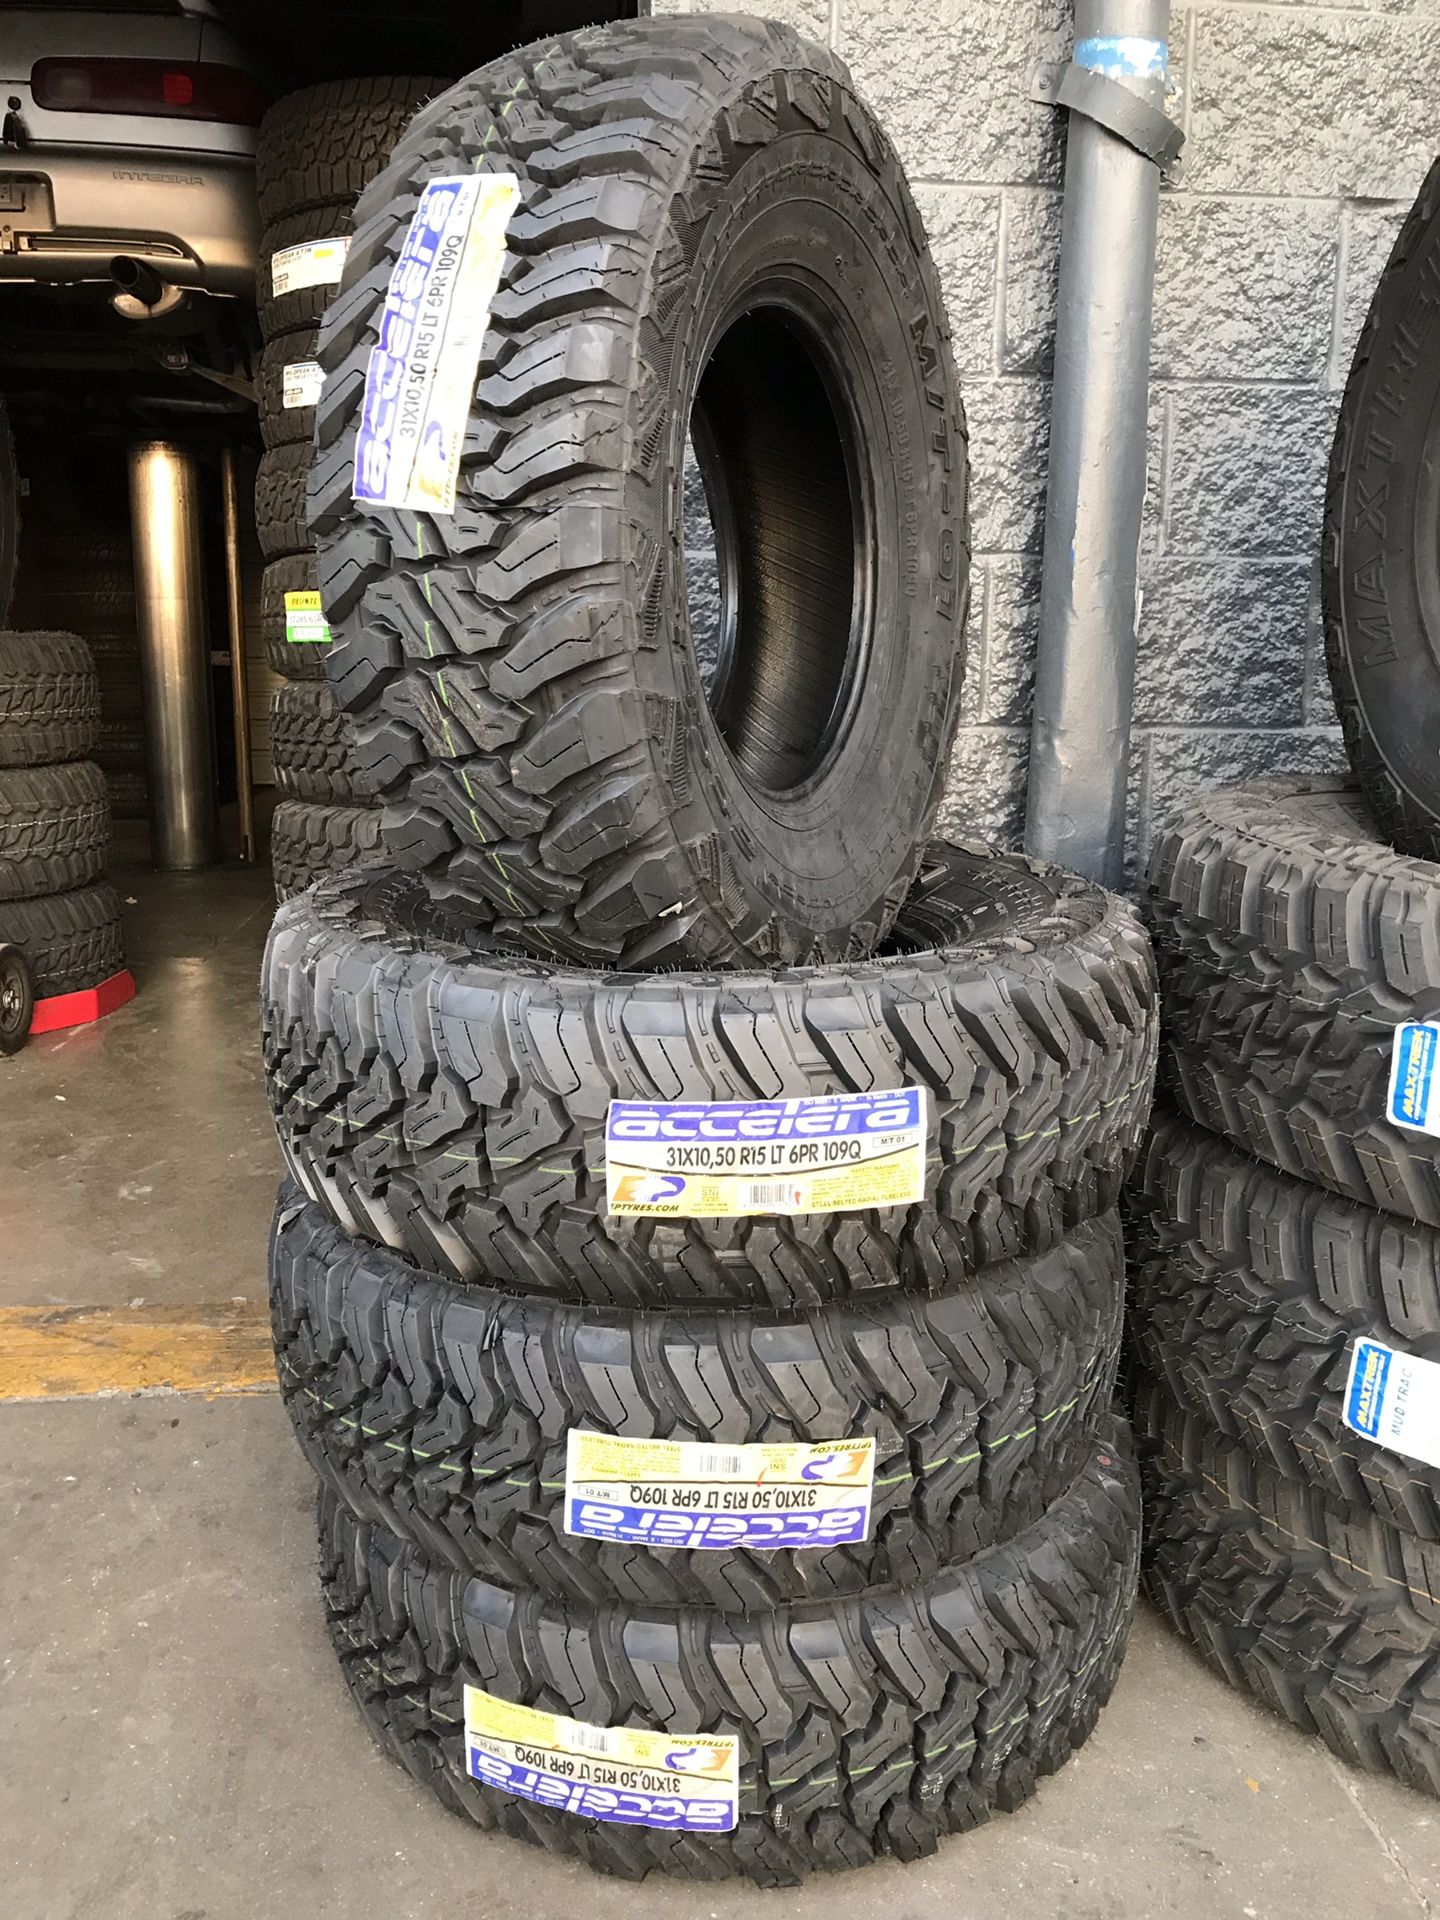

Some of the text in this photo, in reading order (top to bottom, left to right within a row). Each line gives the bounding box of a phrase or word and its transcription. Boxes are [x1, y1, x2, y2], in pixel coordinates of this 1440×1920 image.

[112, 169, 206, 186] INTEGRA
[435, 234, 465, 272] 109Q
[421, 312, 438, 328] LT
[414, 332, 436, 359] R15
[400, 362, 427, 438] 31X10,50
[612, 1099, 910, 1137] accelera
[666, 1140, 862, 1169] 31X10,50 R15 LT 6PR 109Q
[1391, 1368, 1413, 1437] MUD TRAC
[630, 1484, 817, 1509] 31X10,50 R15 LT 6PR 109Q
[580, 1504, 862, 1546] accelera
[515, 1745, 681, 1793] 31X10,50 R15 LT 6PR 109Q
[478, 1754, 730, 1824] accelera
